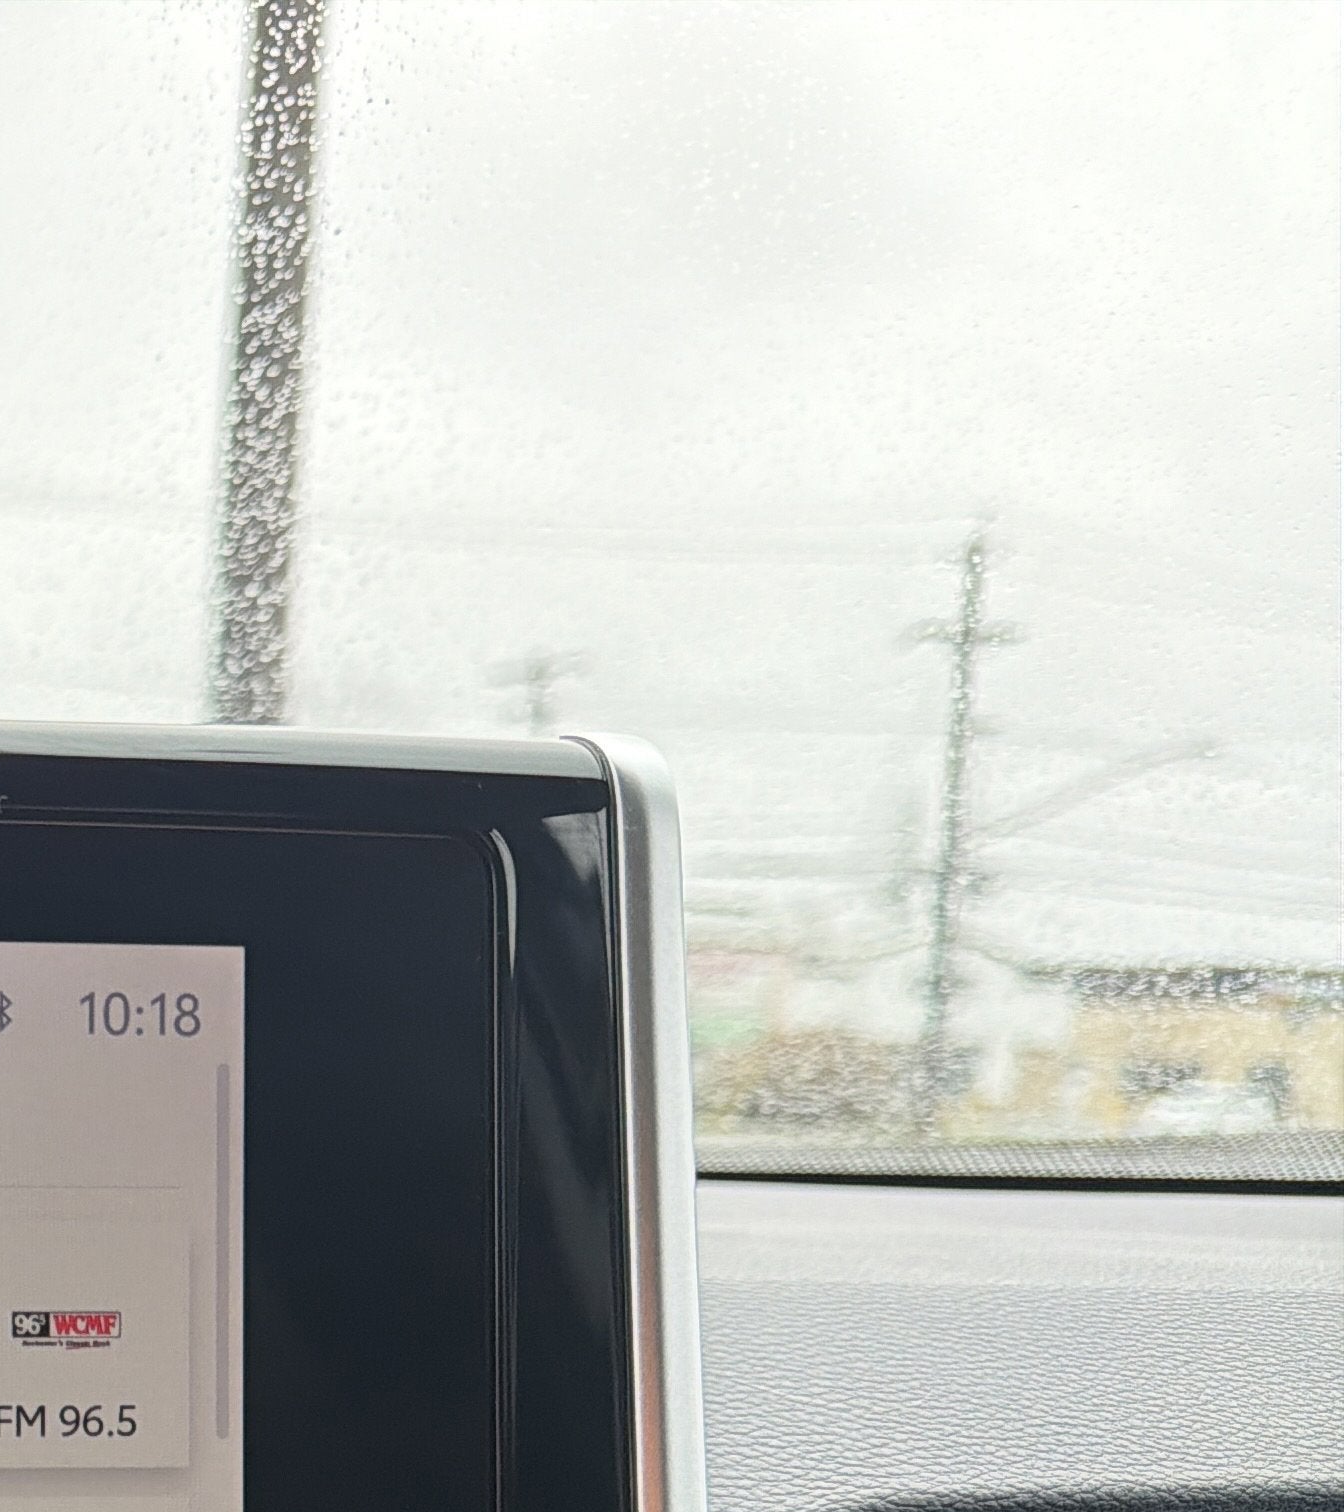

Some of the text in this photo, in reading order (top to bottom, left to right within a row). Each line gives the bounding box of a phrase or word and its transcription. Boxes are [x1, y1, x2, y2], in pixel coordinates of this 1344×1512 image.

[79, 991, 201, 1038] 10:18
[53, 1314, 117, 1335] WCMF
[58, 1404, 137, 1437] 96.5
